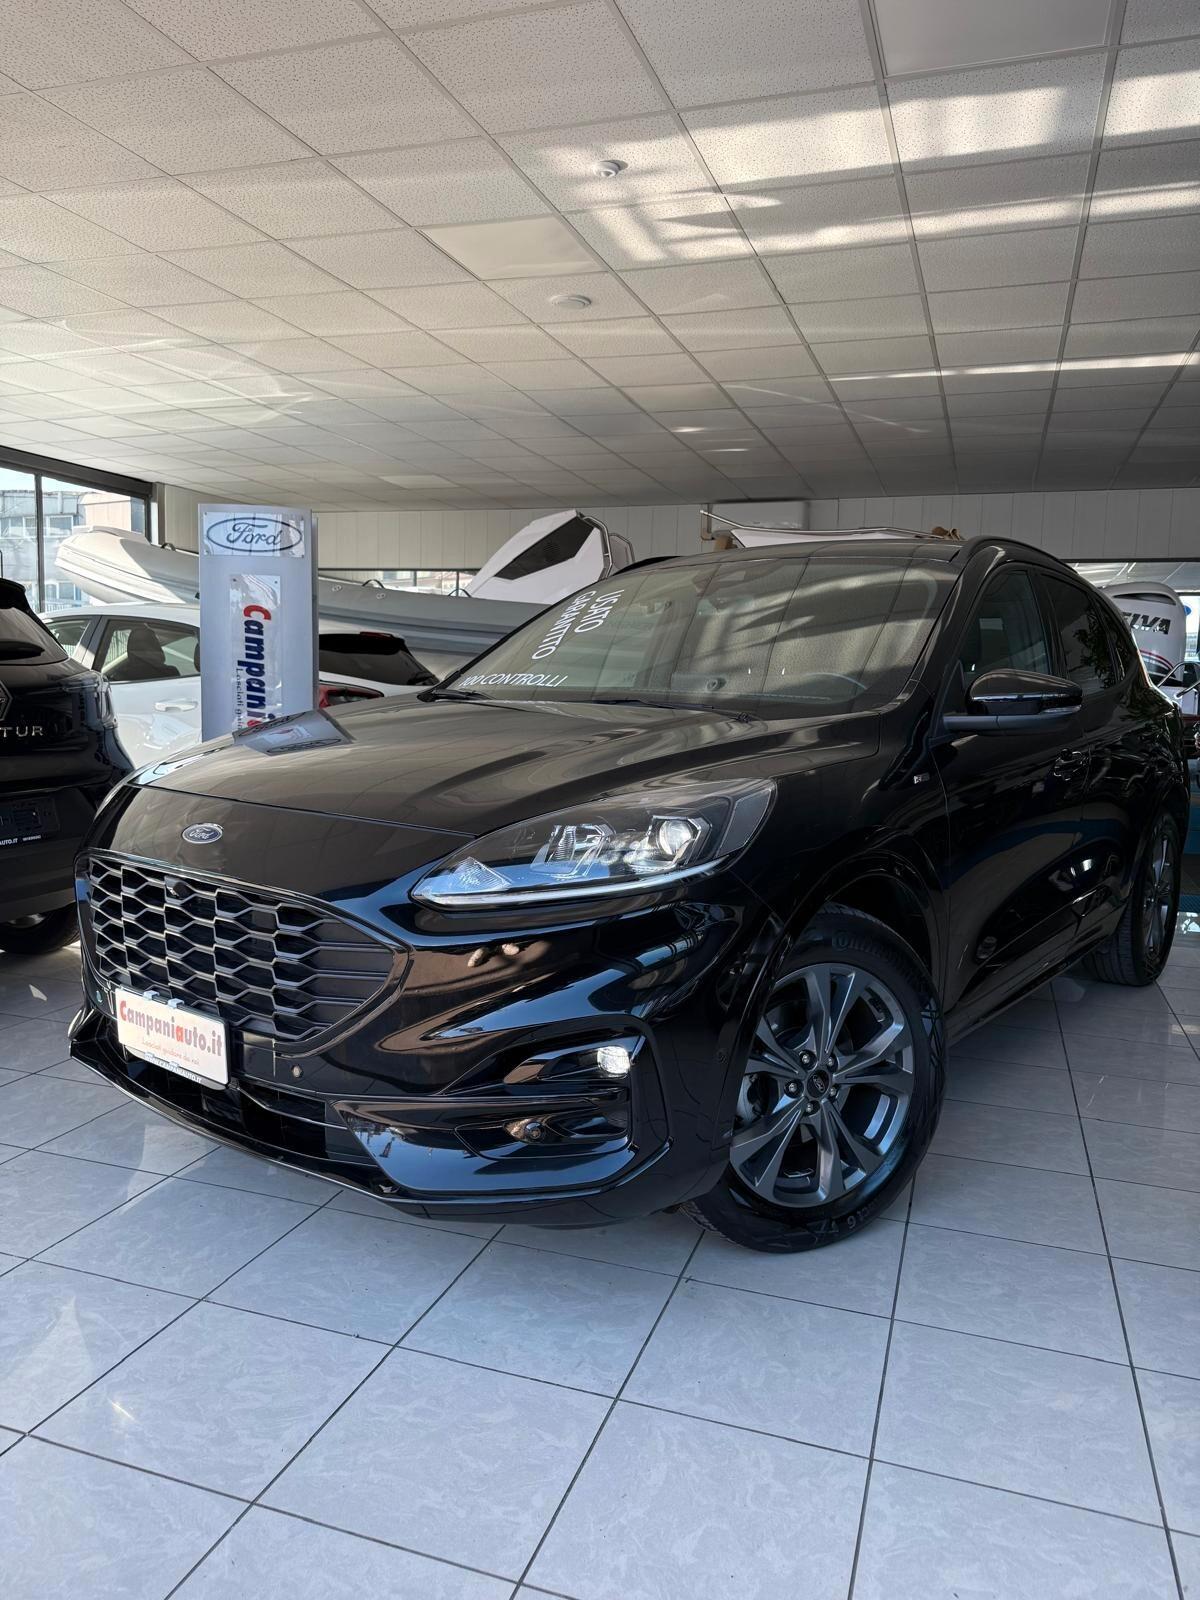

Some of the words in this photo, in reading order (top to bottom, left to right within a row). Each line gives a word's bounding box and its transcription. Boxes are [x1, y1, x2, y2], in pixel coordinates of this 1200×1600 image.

[226, 522, 283, 545] Ford
[531, 590, 597, 660] GARANTITO
[574, 589, 625, 633] USATO
[480, 673, 568, 688] CONTROLLI
[119, 1000, 223, 1057] Campaniauto.it
